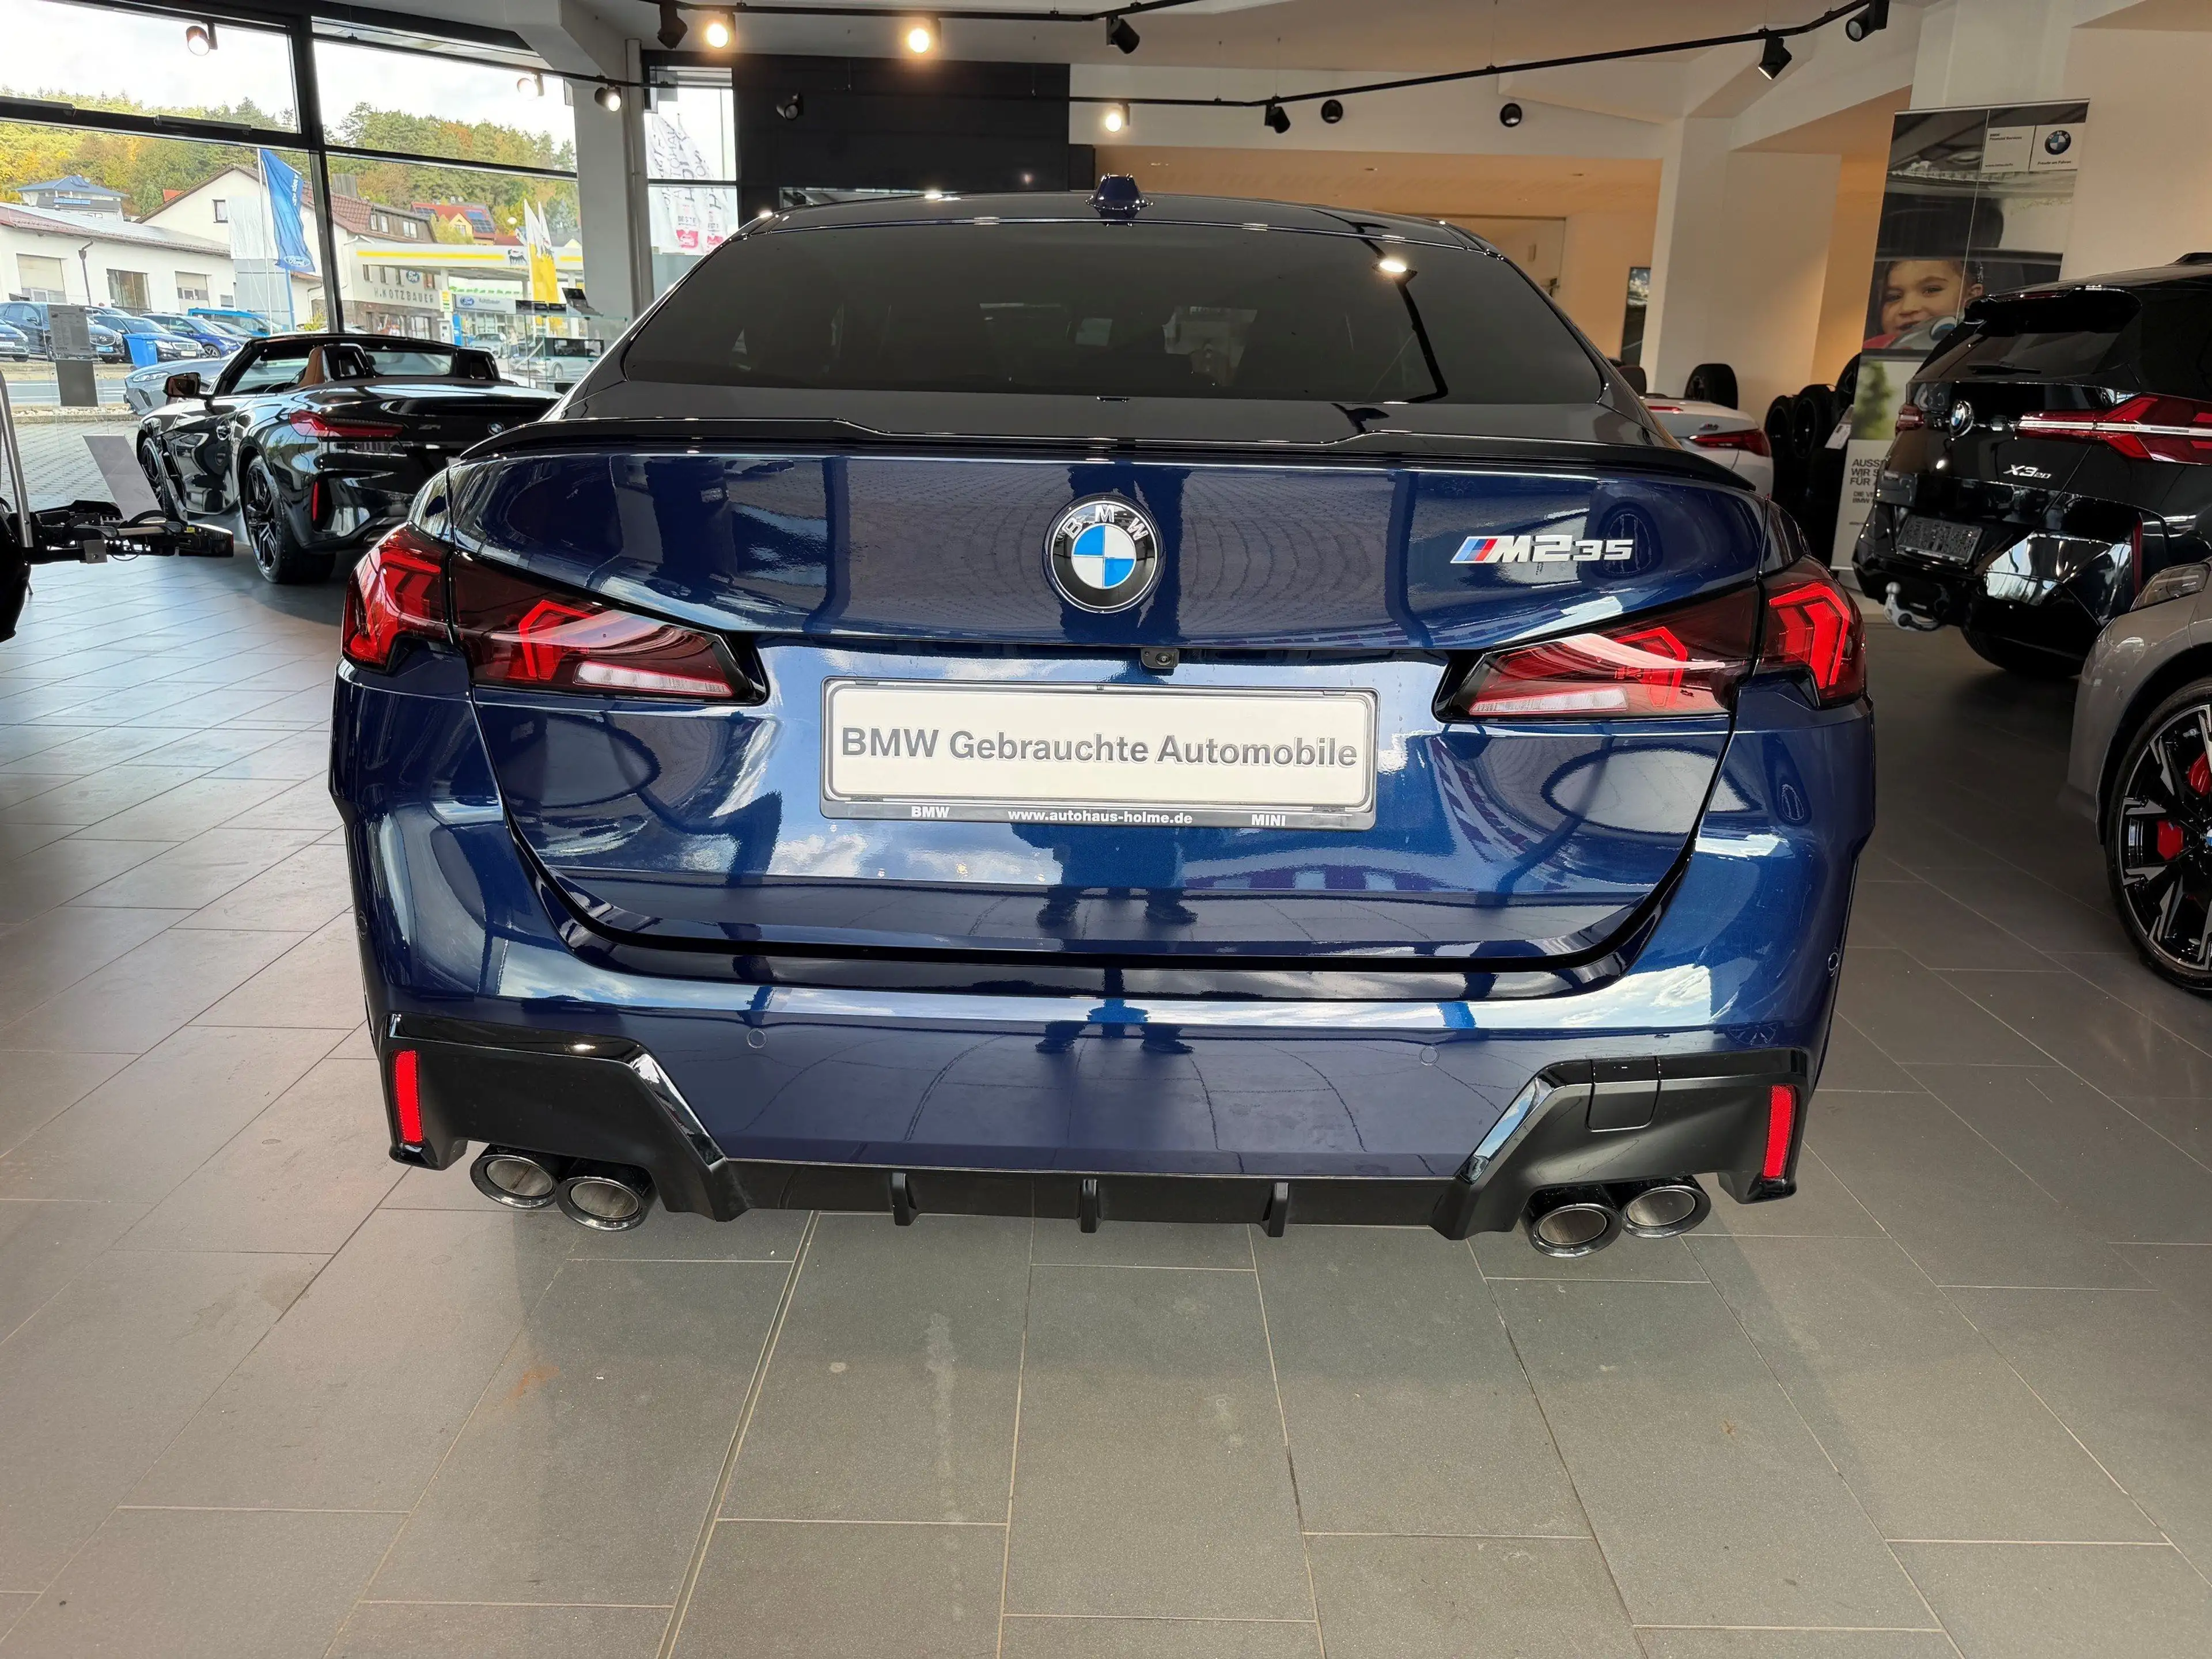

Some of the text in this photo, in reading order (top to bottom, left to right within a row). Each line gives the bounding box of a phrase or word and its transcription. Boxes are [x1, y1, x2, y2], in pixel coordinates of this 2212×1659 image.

[1851, 468, 1870, 476] WIR
[1062, 504, 1148, 541] BMW
[842, 727, 1358, 766] BMW Gebrauchte Automobile
[911, 806, 1286, 826] BMW www.autohaus-holme.de MINI
